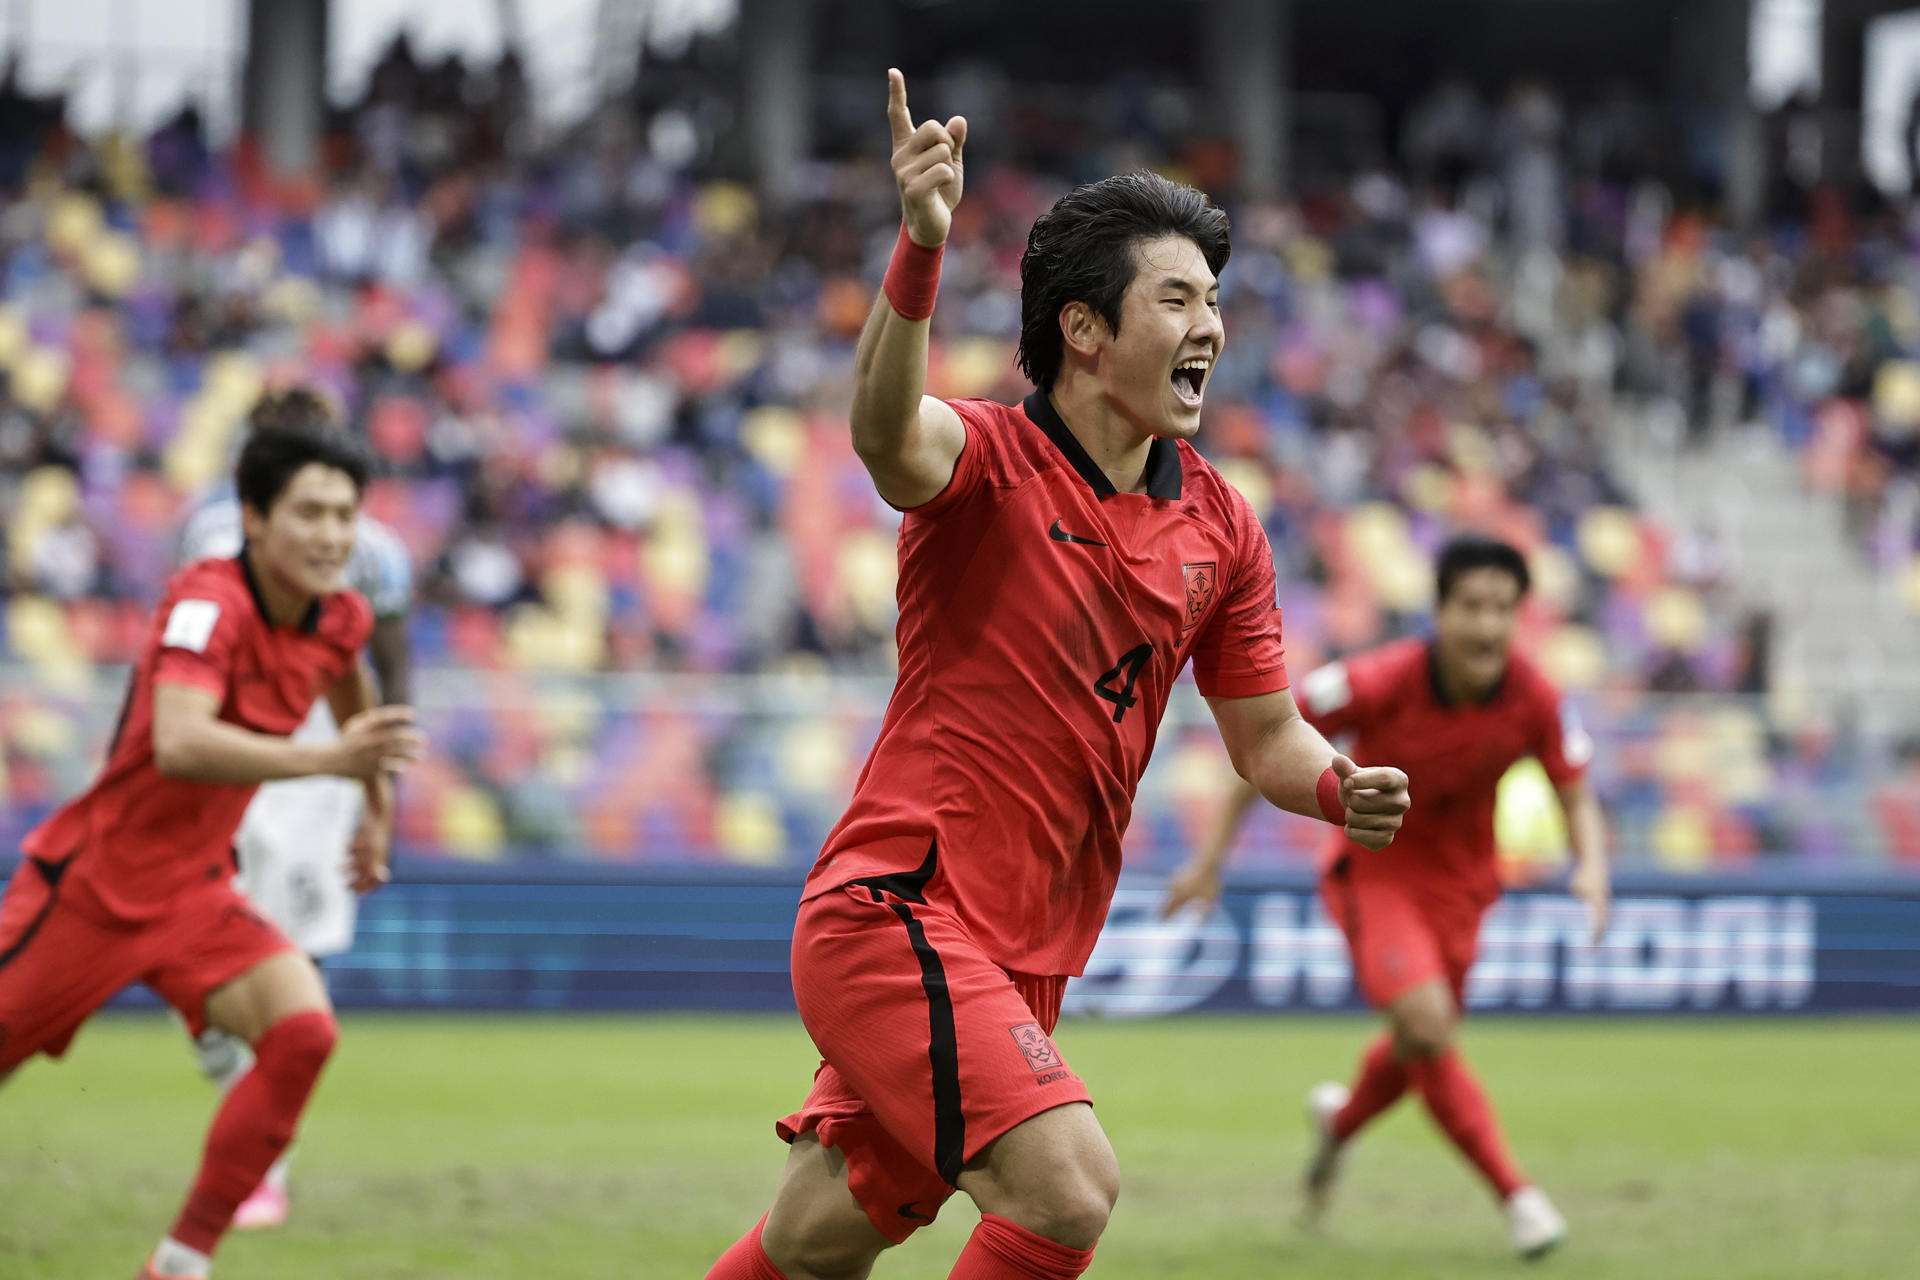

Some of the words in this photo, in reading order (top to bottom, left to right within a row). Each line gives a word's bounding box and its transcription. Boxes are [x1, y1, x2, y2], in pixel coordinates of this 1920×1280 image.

[1094, 643, 1153, 723] 4
[1250, 891, 1815, 1008] HNDAI
[1037, 1071, 1069, 1086] KOREA
